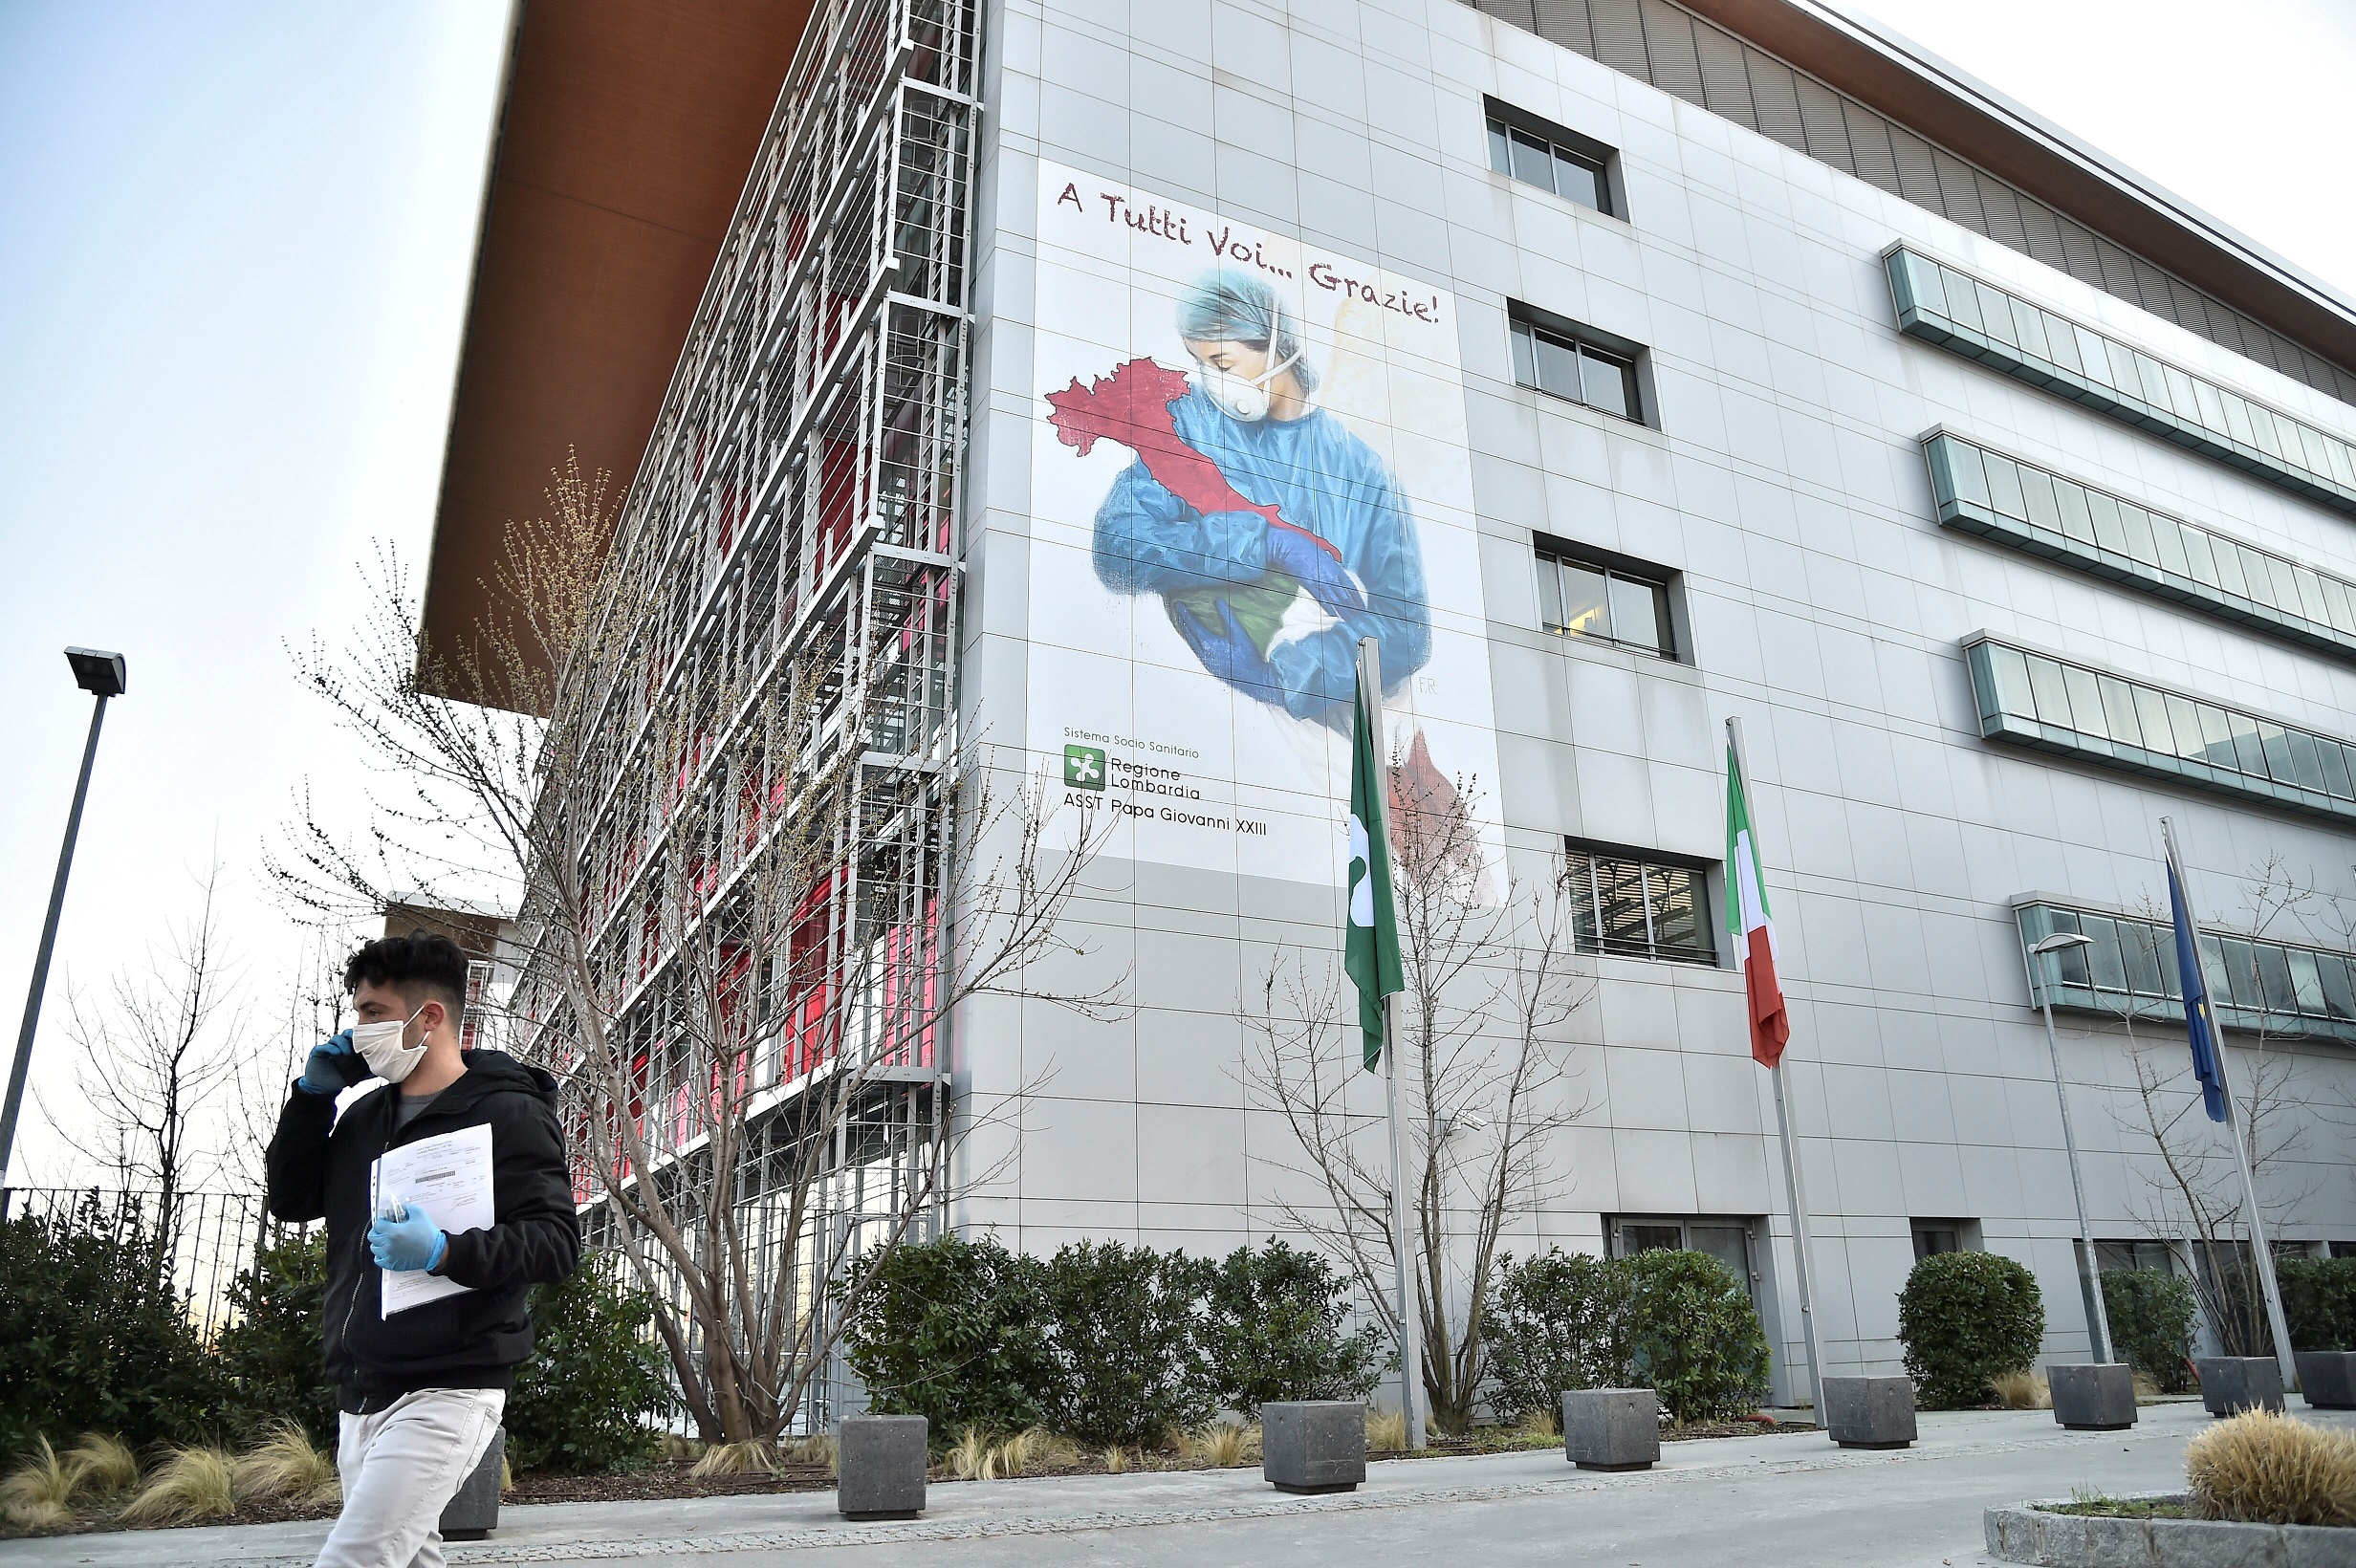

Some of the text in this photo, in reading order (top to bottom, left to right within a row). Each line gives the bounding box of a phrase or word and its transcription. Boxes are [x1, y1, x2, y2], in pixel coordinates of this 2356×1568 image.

[1058, 182, 1440, 324] A Tutti Voi... Grazie!
[1063, 727, 1199, 759] Sistema Socio Sanitario
[1111, 757, 1181, 781] Regione
[1111, 773, 1200, 800] Lombardia
[1063, 793, 1267, 837] ASST Papa Giovanni XXIII
